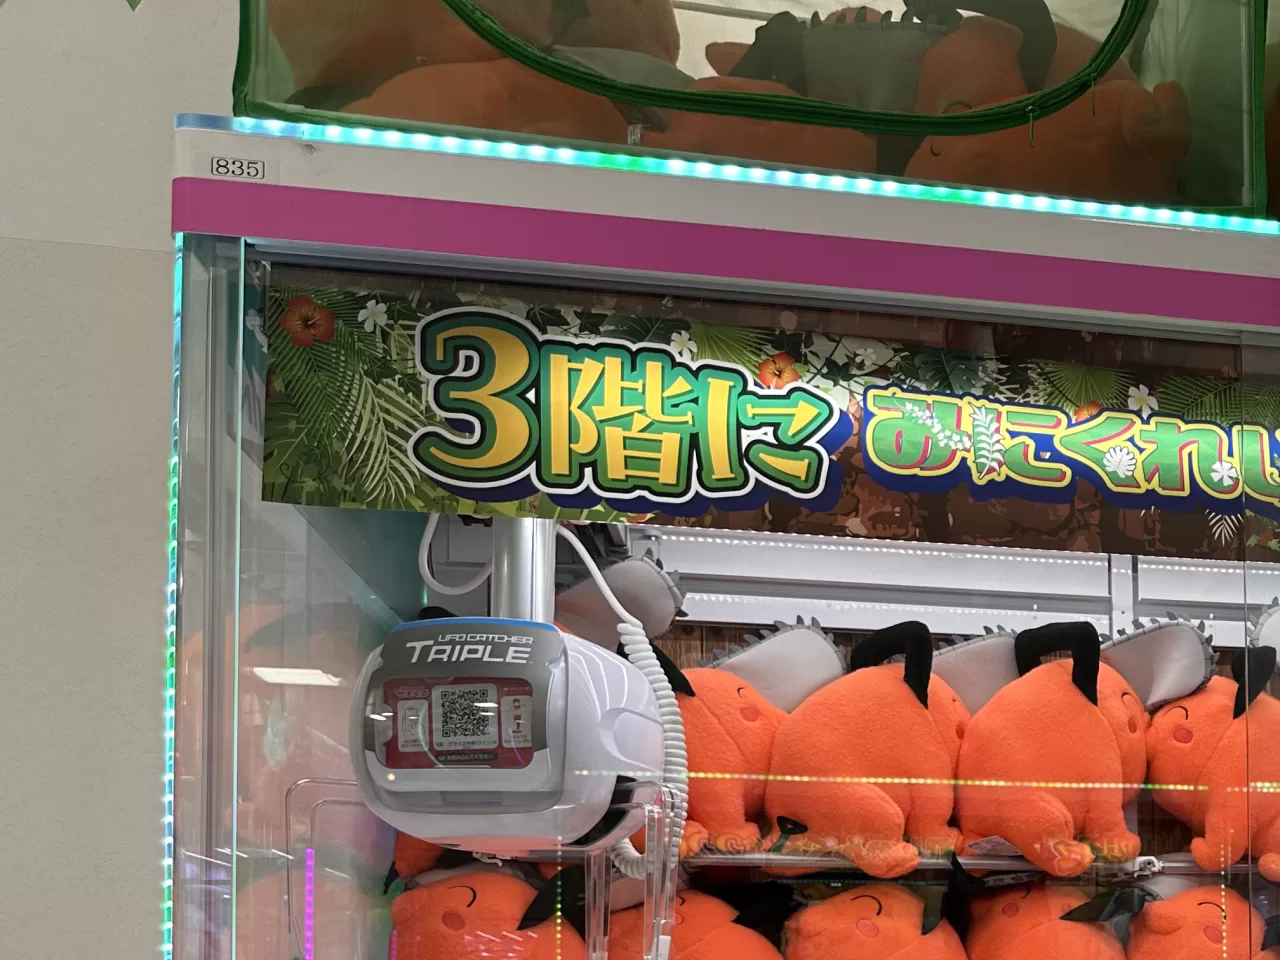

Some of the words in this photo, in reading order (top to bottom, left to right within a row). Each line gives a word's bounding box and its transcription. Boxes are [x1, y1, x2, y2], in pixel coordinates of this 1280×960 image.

[214, 159, 262, 178] 835
[412, 312, 836, 500] 3階に
[438, 634, 465, 643] UFO
[465, 634, 534, 645] CATCHER
[405, 640, 532, 664] TRIPLE
